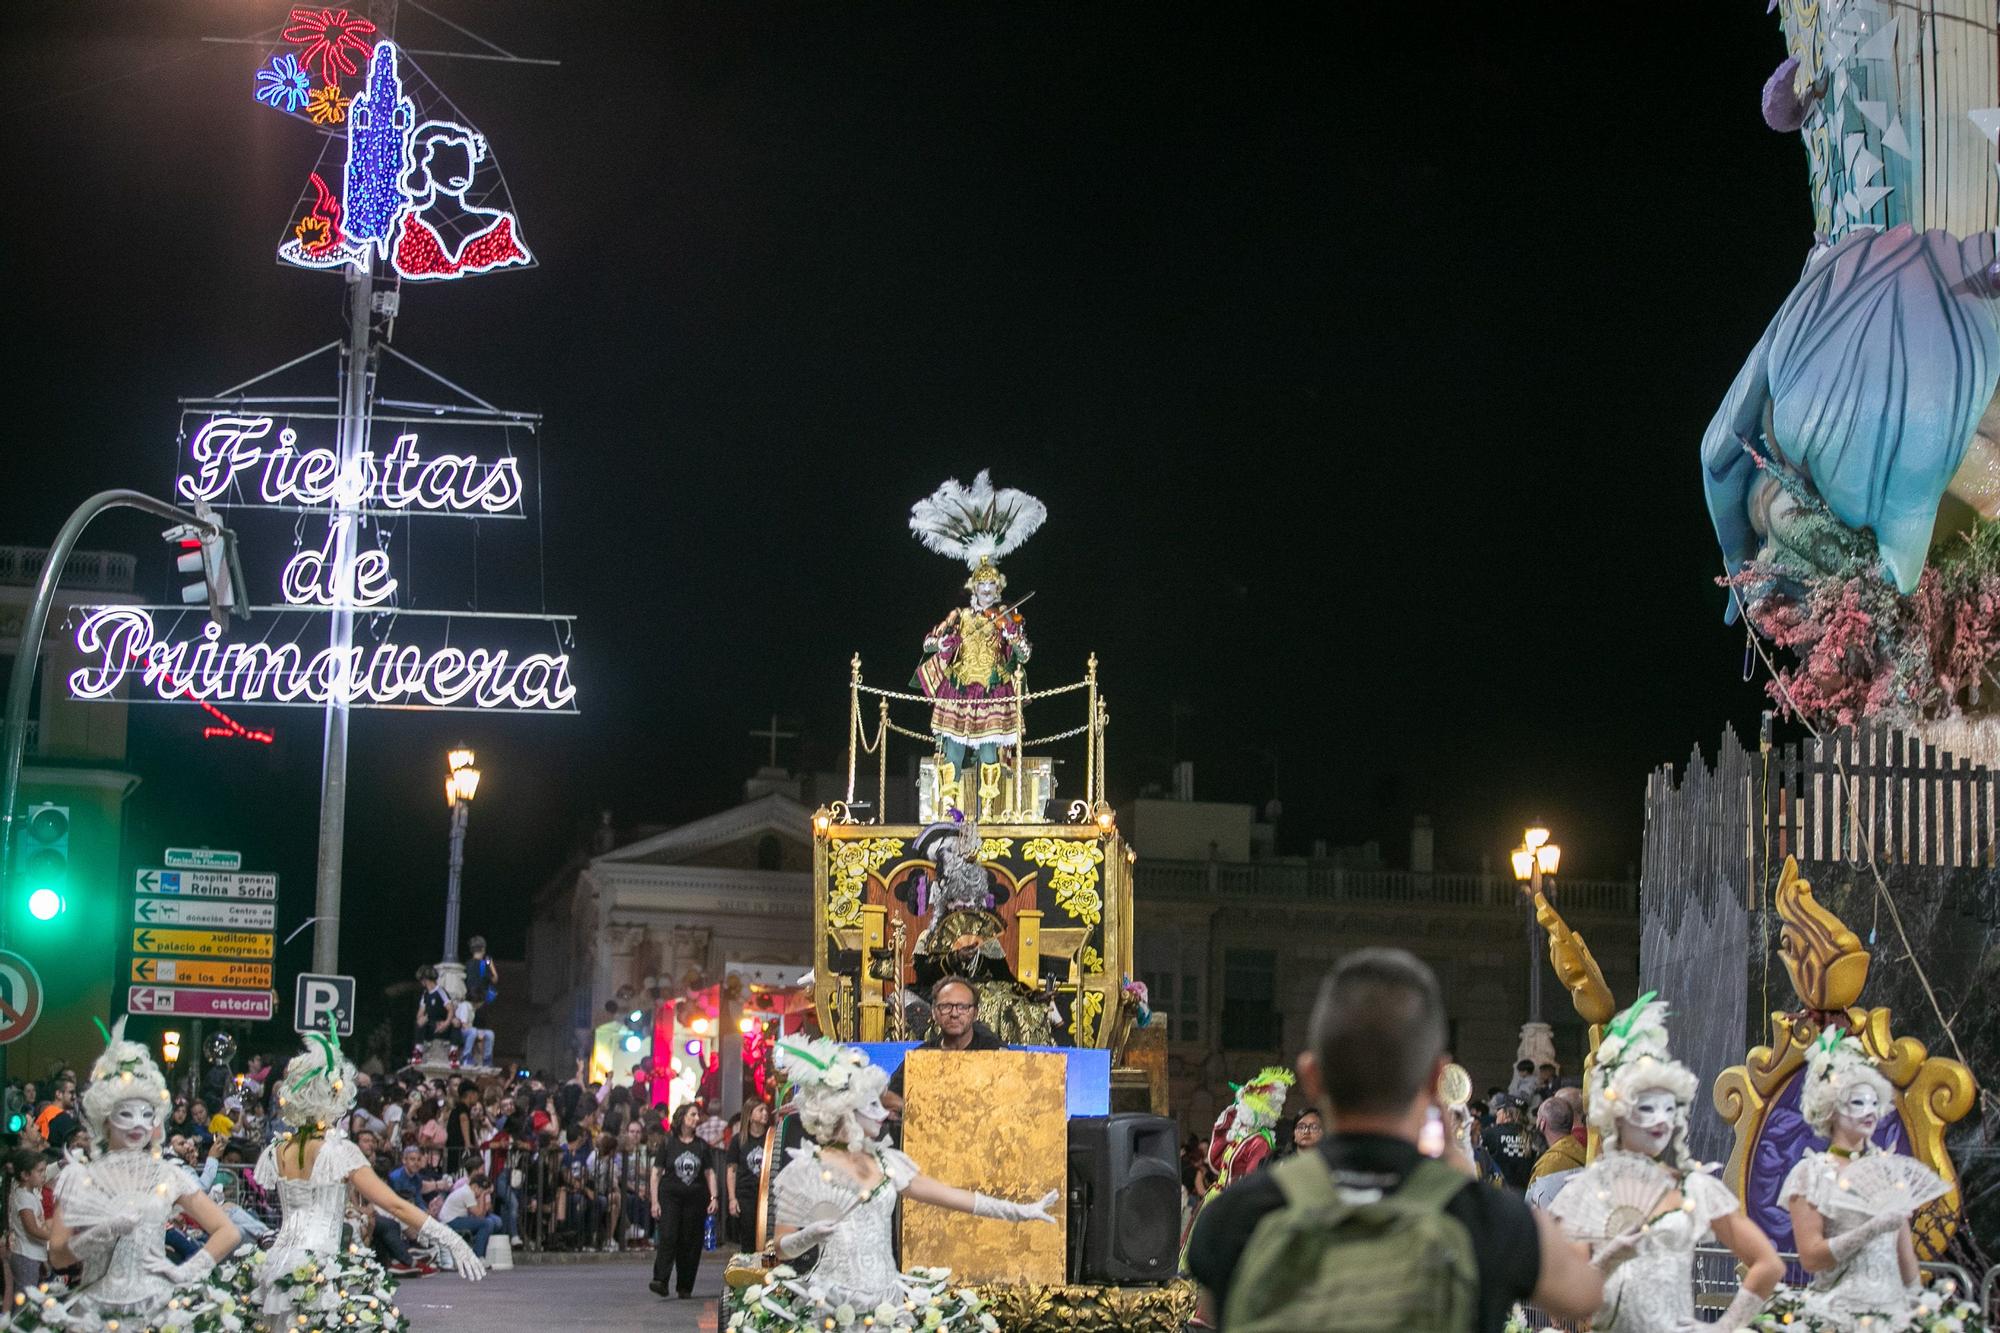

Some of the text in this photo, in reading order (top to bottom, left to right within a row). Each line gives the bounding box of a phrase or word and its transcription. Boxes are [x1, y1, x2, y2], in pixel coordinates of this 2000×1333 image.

[177, 416, 523, 512] Fiestas
[281, 515, 399, 606] de
[68, 606, 578, 711] Primavera
[192, 873, 274, 885] hospital general
[191, 883, 228, 896] Reina
[238, 885, 273, 898] Sofía
[229, 907, 272, 916] Centro de
[186, 913, 272, 926] donación de sangre
[211, 934, 271, 945] auditorio y
[157, 942, 270, 956] palacio de congresos
[229, 964, 270, 975] palacio
[179, 972, 269, 985] de los deportes
[211, 997, 269, 1011] catedral
[304, 980, 339, 1027] P
